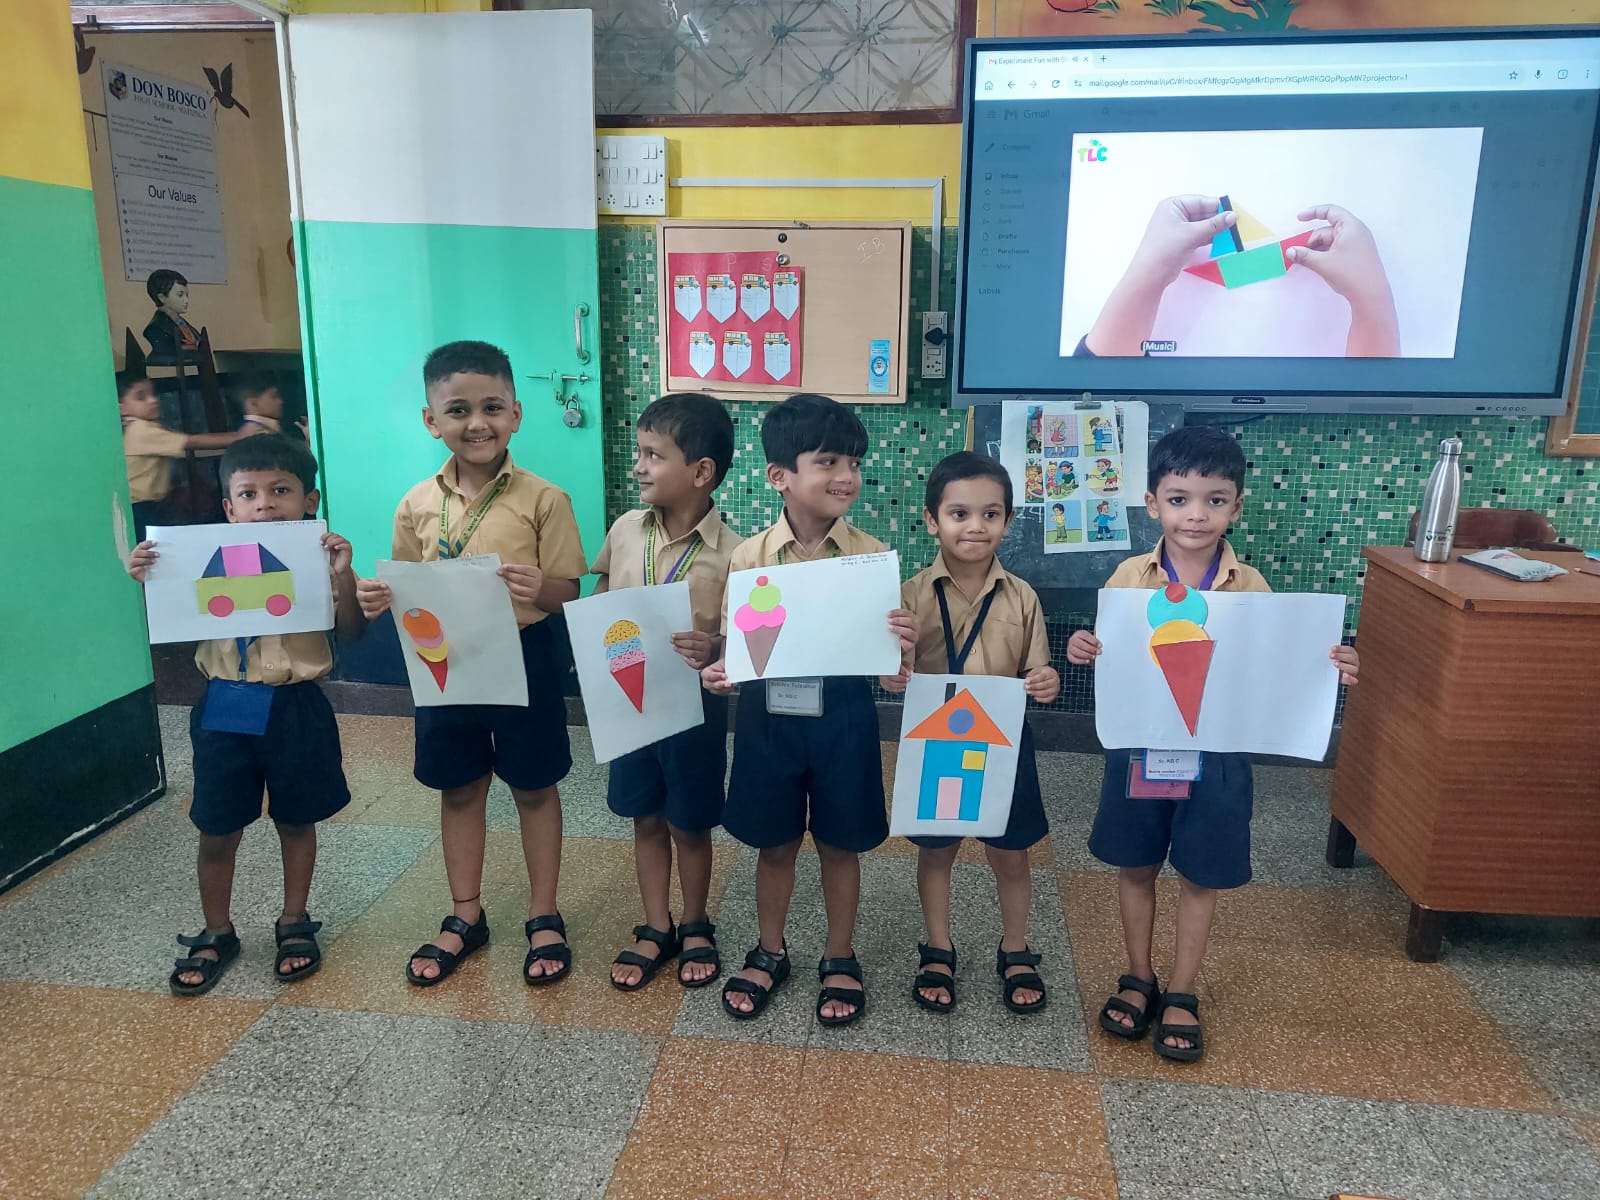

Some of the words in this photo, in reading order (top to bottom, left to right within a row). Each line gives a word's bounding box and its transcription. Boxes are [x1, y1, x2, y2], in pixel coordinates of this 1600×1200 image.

[131, 77, 163, 99] DON
[167, 87, 206, 111] BOSCO
[1023, 109, 1051, 120] Gmail
[1077, 147, 1107, 162] TLC
[148, 184, 166, 200] Our
[167, 187, 197, 204] Values
[1143, 341, 1175, 352] [Music]
